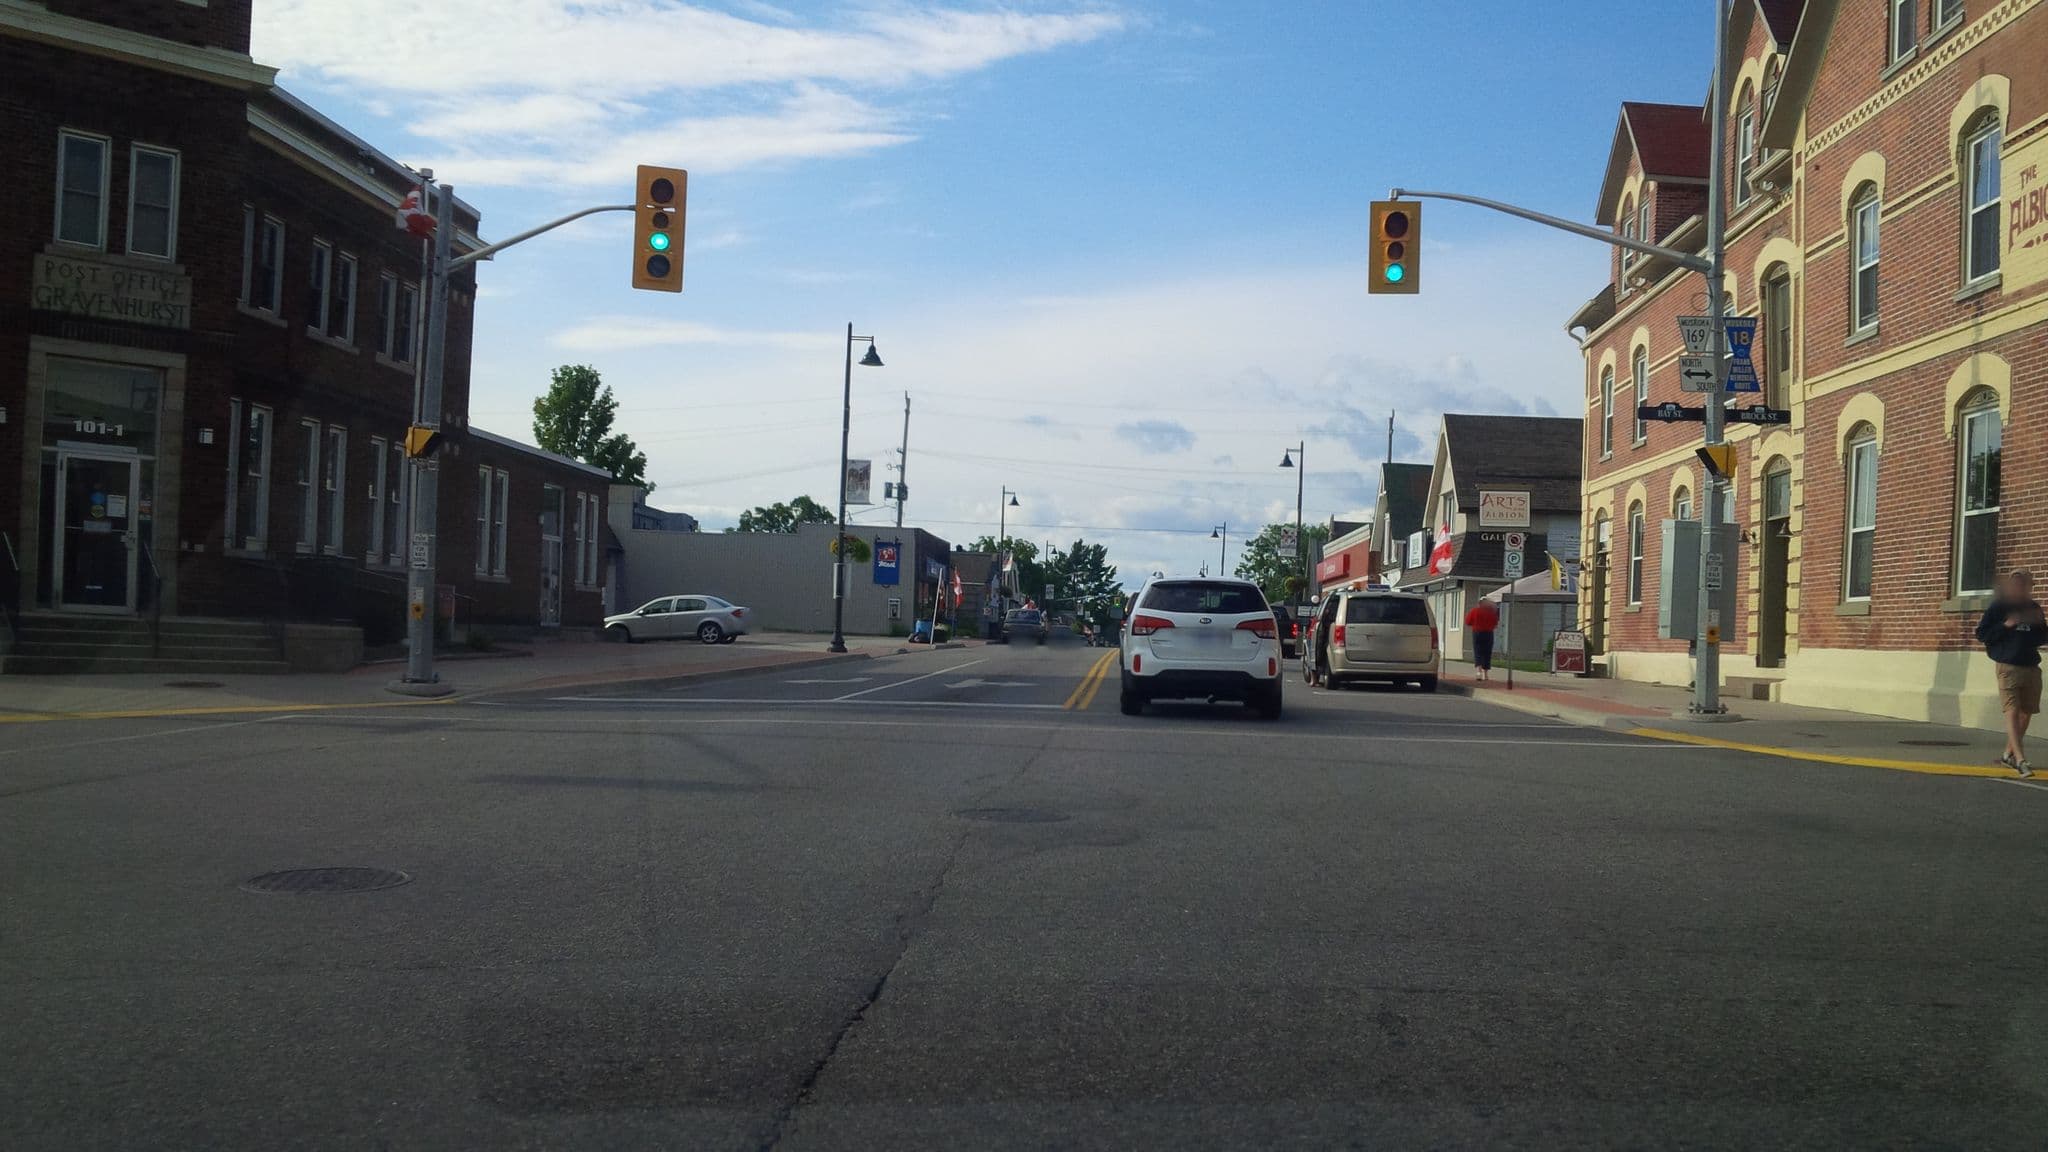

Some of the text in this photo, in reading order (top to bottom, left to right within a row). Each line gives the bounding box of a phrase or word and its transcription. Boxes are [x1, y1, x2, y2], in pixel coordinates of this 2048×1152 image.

[2020, 164, 2037, 188] THE
[44, 261, 184, 295] POST OFFICE
[36, 285, 188, 322] GRAVENHURST
[1687, 329, 1705, 342] 169
[1733, 331, 1749, 345] 18
[1682, 359, 1702, 367] NORTH
[1658, 409, 1671, 417] BAY
[73, 420, 124, 436] 101-1
[1481, 493, 1526, 509] ARTS
[1485, 511, 1525, 519] ALBION
[1481, 533, 1529, 541] GALLY
[1555, 633, 1584, 641] ARTS
